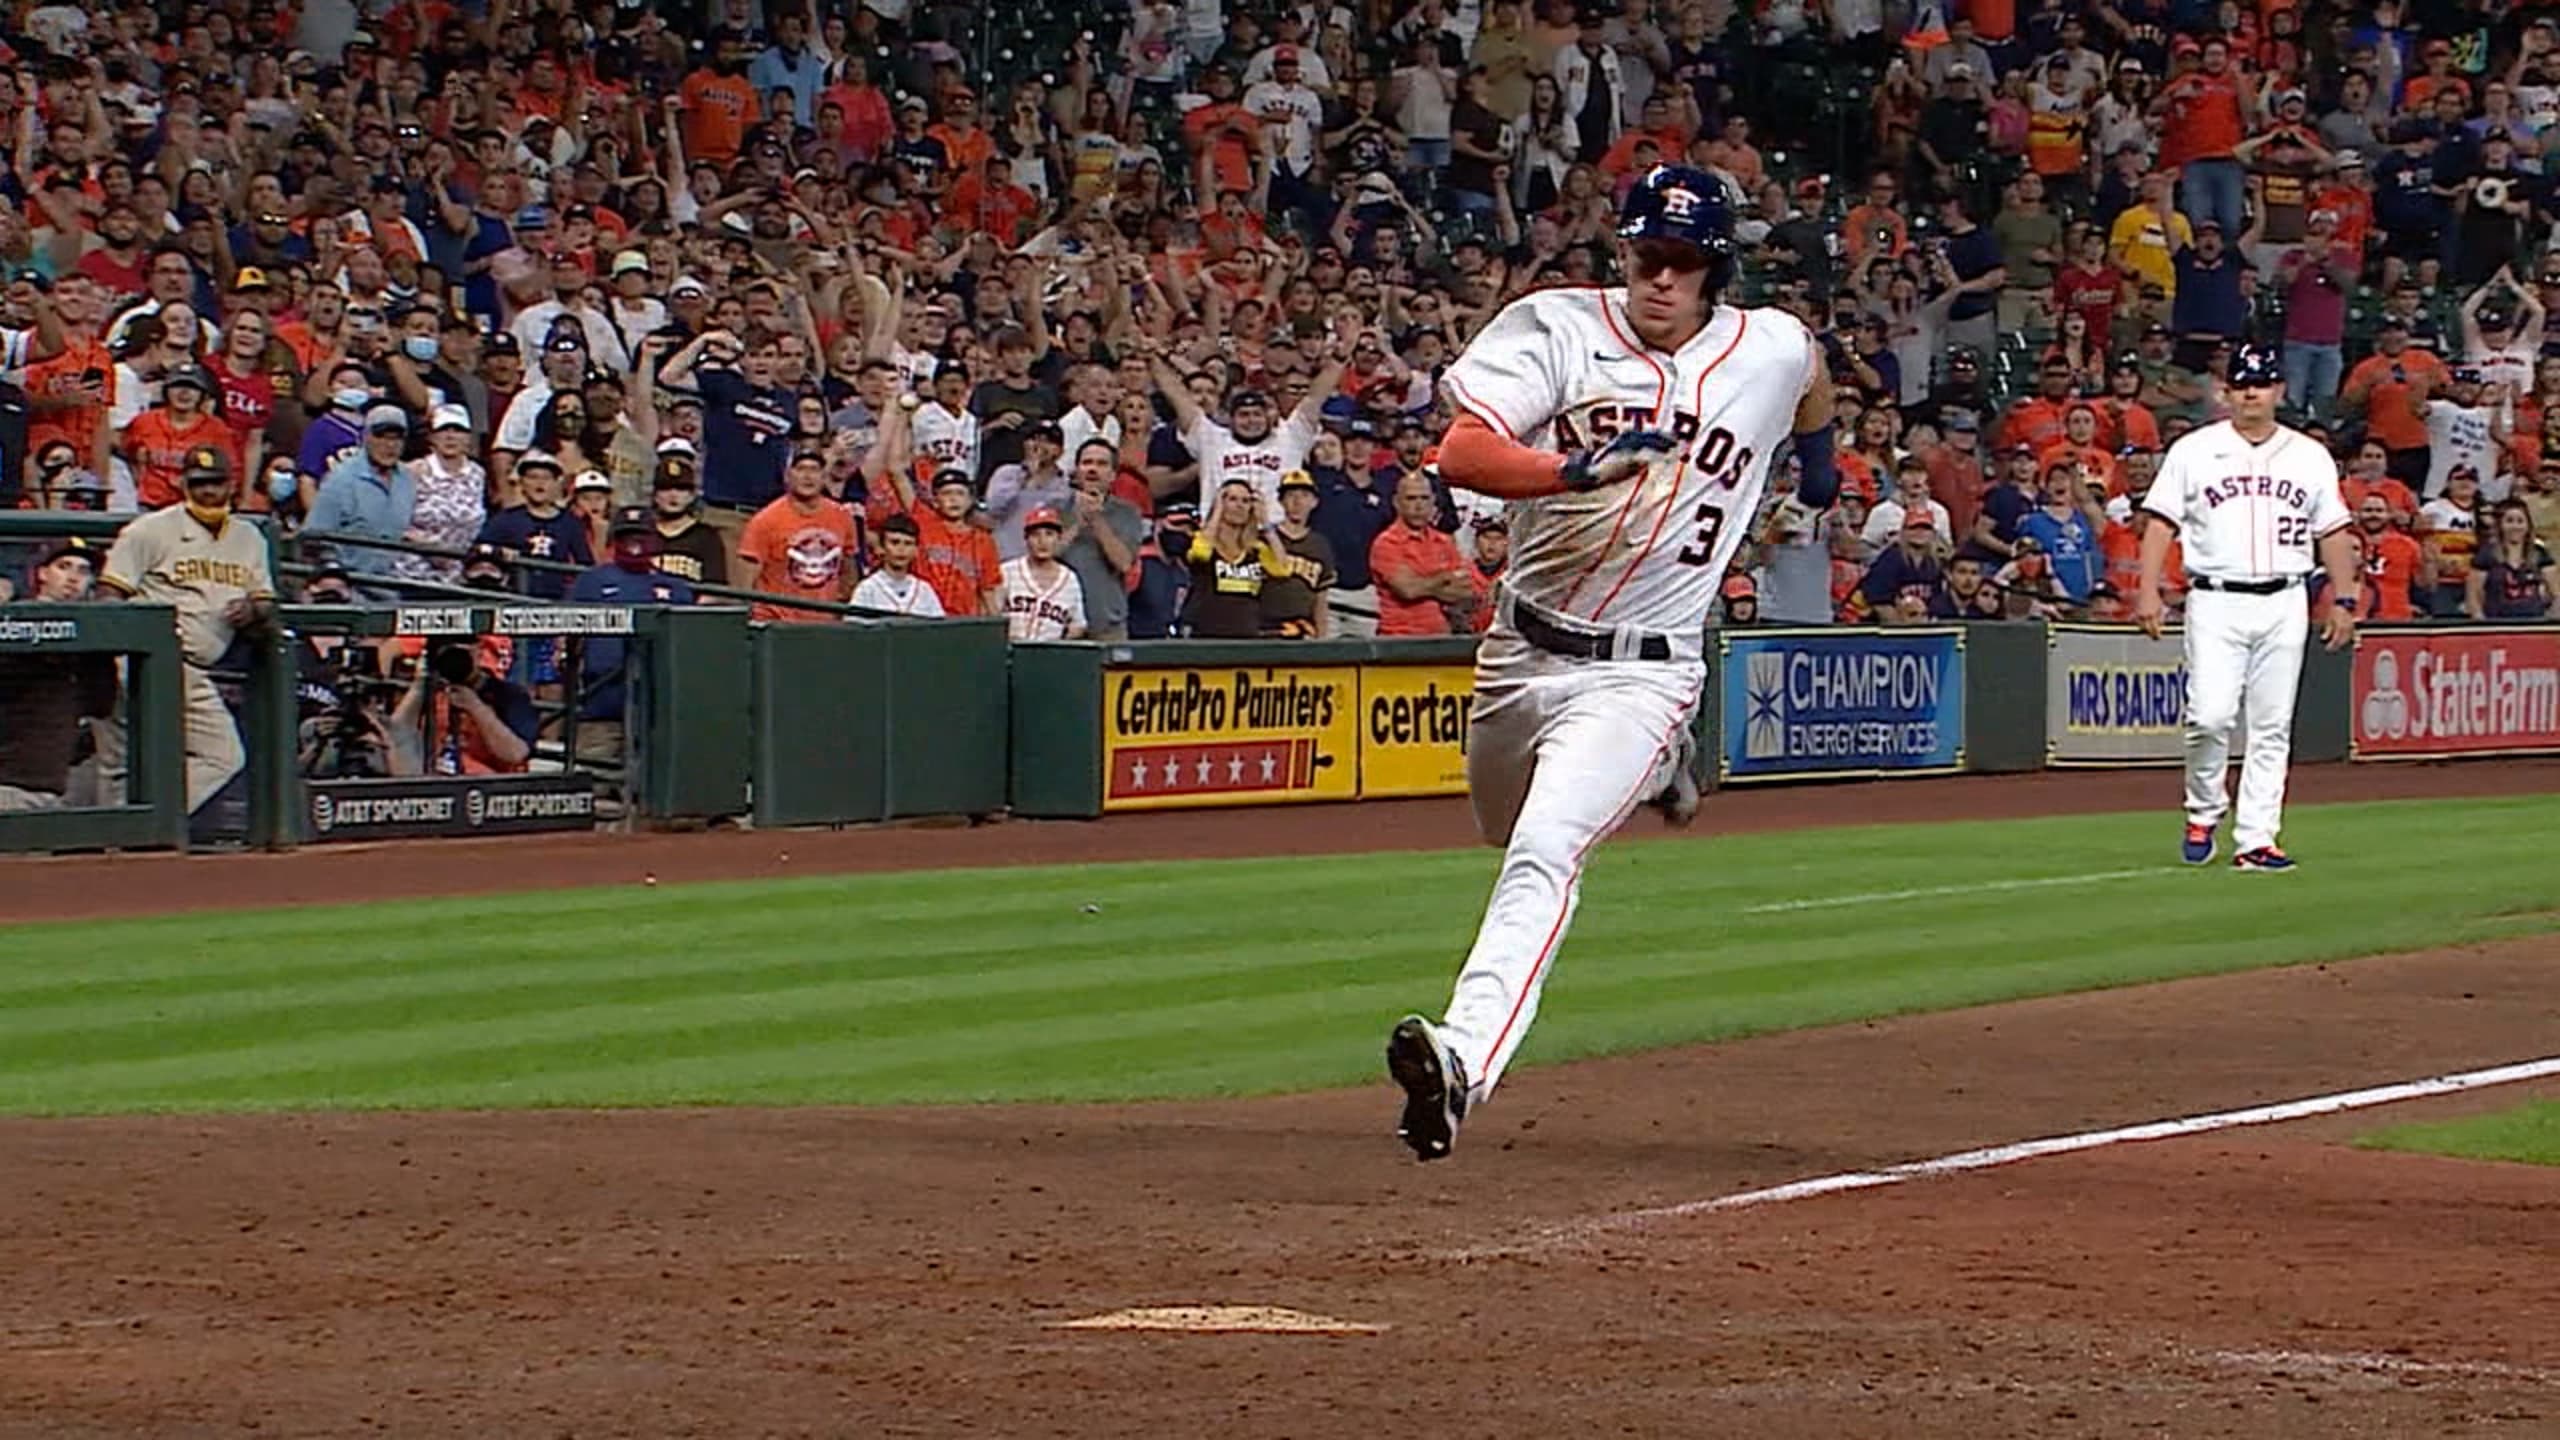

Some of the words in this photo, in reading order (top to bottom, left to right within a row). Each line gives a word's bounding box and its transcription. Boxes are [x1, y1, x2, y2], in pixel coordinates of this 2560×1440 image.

[2204, 475, 2308, 509] ASTROS
[1677, 503, 1724, 567] 3
[2278, 515, 2308, 546] 22
[1115, 671, 1226, 735] CertaPro
[1232, 667, 1334, 730] Painters
[1788, 650, 1939, 711] CHAMPION
[2068, 670, 2110, 728] MRS
